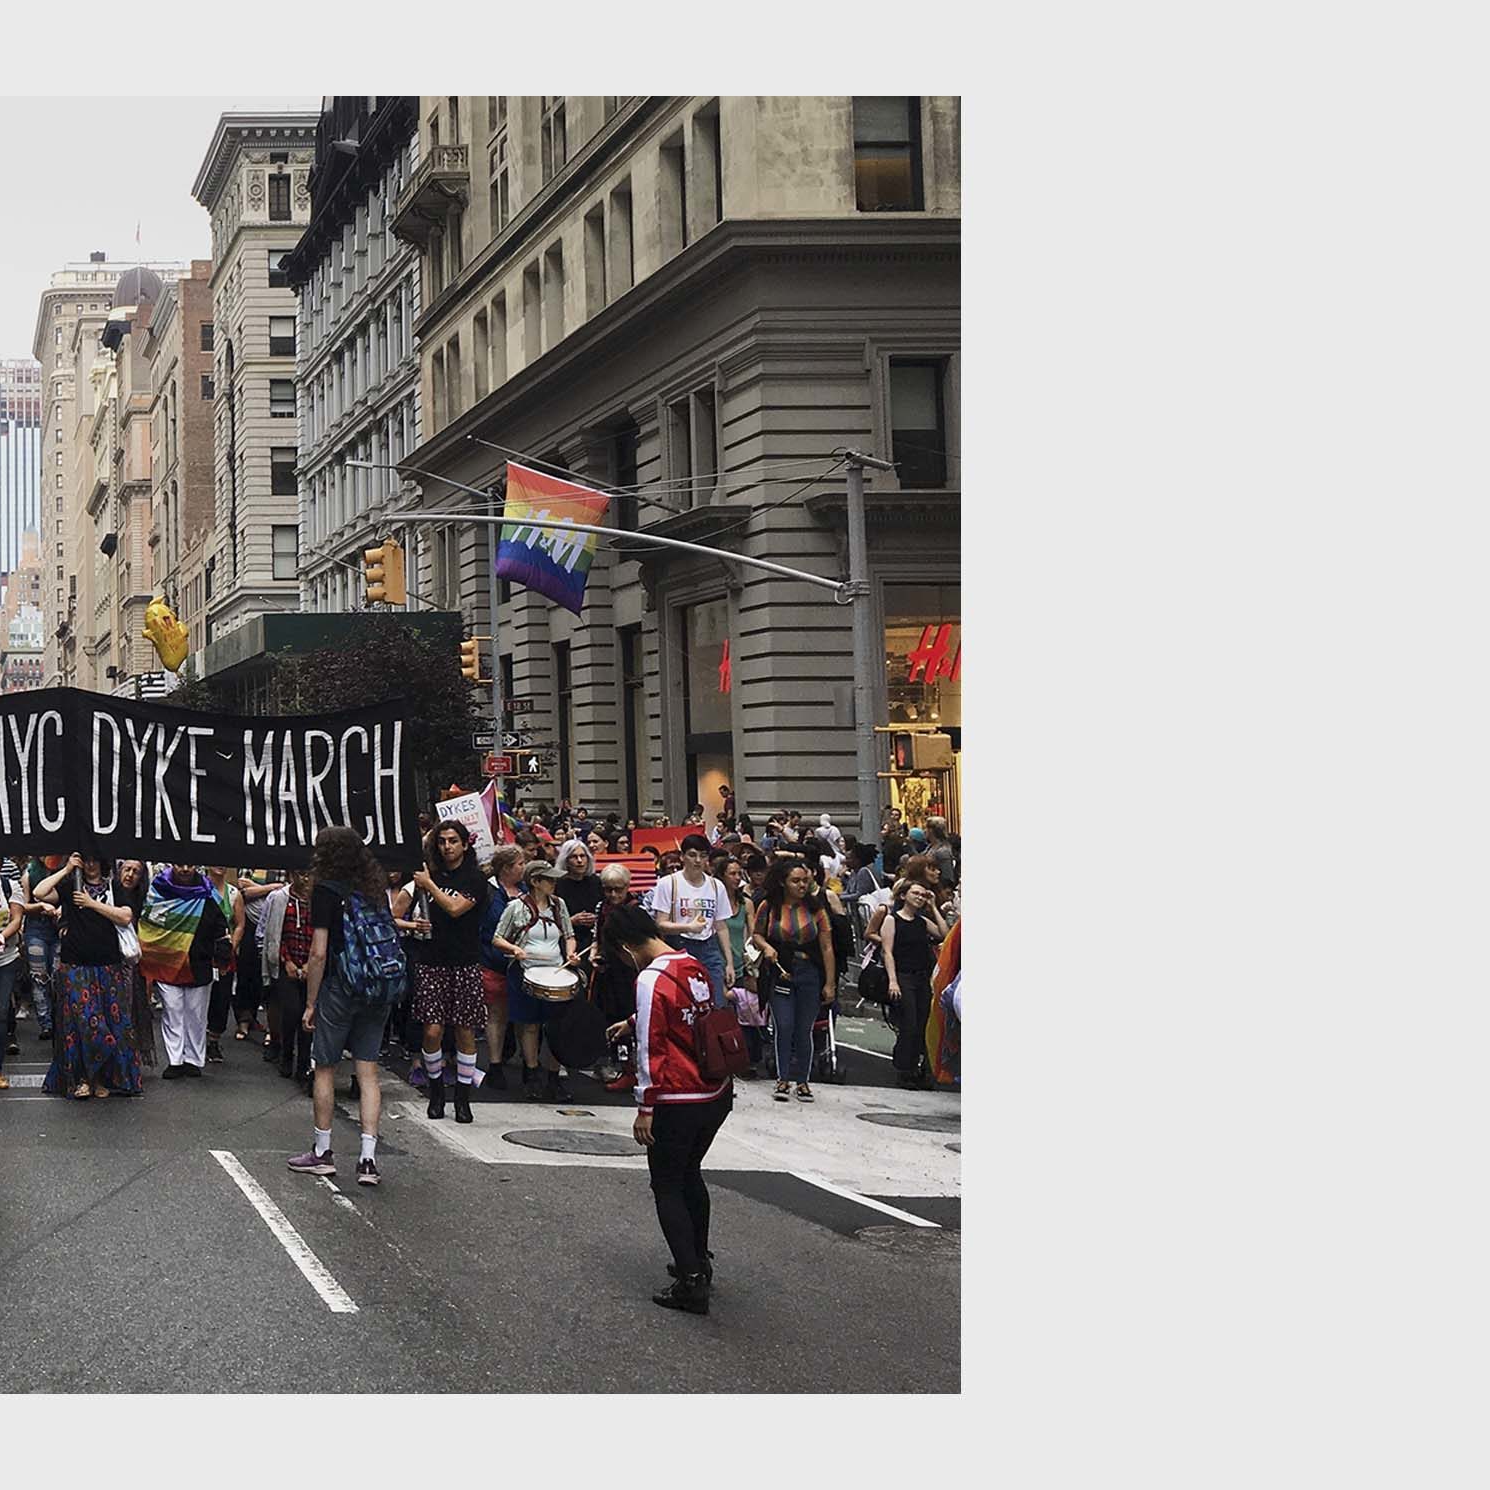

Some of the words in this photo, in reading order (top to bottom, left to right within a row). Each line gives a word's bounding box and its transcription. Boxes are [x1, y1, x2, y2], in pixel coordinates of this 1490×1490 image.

[510, 507, 588, 574] H&M
[92, 711, 216, 843] DYKE
[243, 721, 404, 846] MARCH
[439, 800, 476, 818] DYKES
[680, 898, 690, 907] IT
[693, 898, 715, 909] GETS
